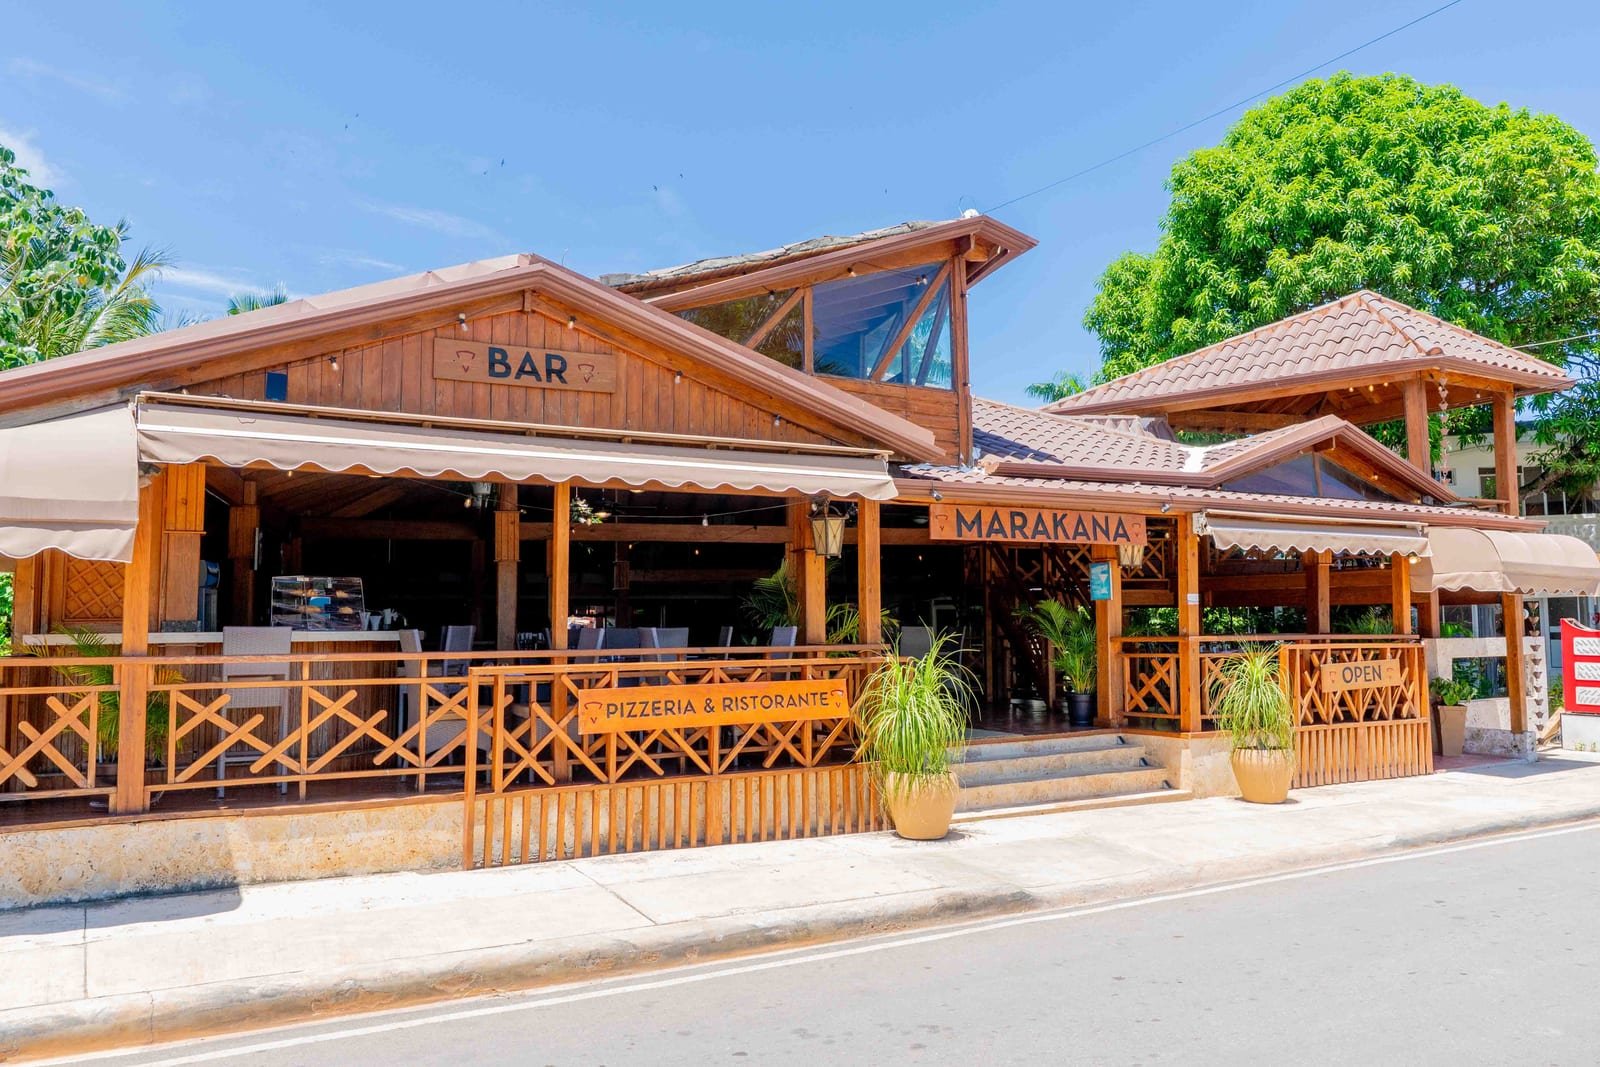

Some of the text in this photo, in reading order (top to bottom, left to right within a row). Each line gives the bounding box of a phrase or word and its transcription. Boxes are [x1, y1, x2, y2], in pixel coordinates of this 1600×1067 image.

[488, 346, 568, 384] BAR
[955, 508, 1131, 541] MARAKANA
[1342, 665, 1382, 683] OPEN
[606, 692, 829, 718] PIZZERIA & RISTORANTE
